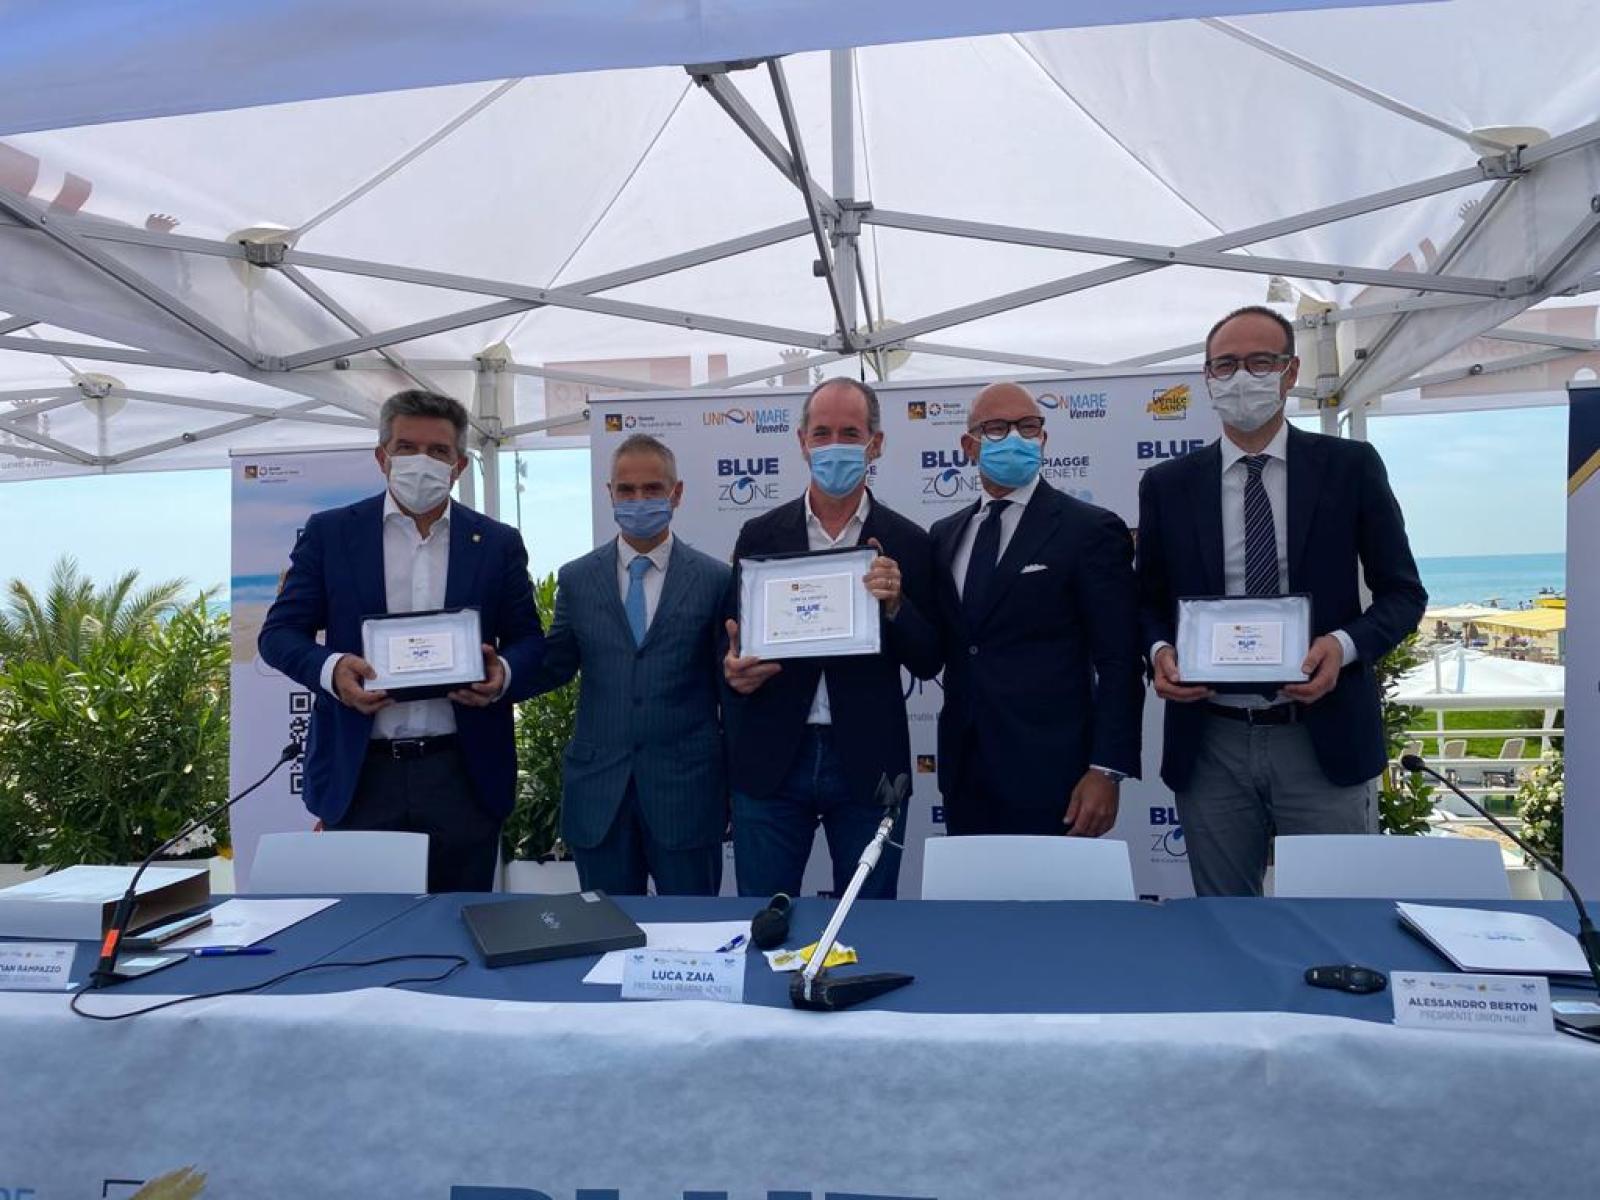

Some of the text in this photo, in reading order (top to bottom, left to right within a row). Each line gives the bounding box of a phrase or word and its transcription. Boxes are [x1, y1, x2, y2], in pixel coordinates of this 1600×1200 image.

[1069, 408, 1106, 419] Veneto
[755, 423, 789, 433] Veneto
[922, 450, 977, 468] BLU
[1041, 456, 1089, 467] PIAGGE
[718, 458, 779, 476] BLUE
[1042, 467, 1088, 478] ENETE
[719, 477, 778, 505] ZONE
[1150, 807, 1180, 825] BL
[652, 969, 715, 983] LUCA ZAIA
[1409, 997, 1538, 1012] ALESSANDRO BERTON
